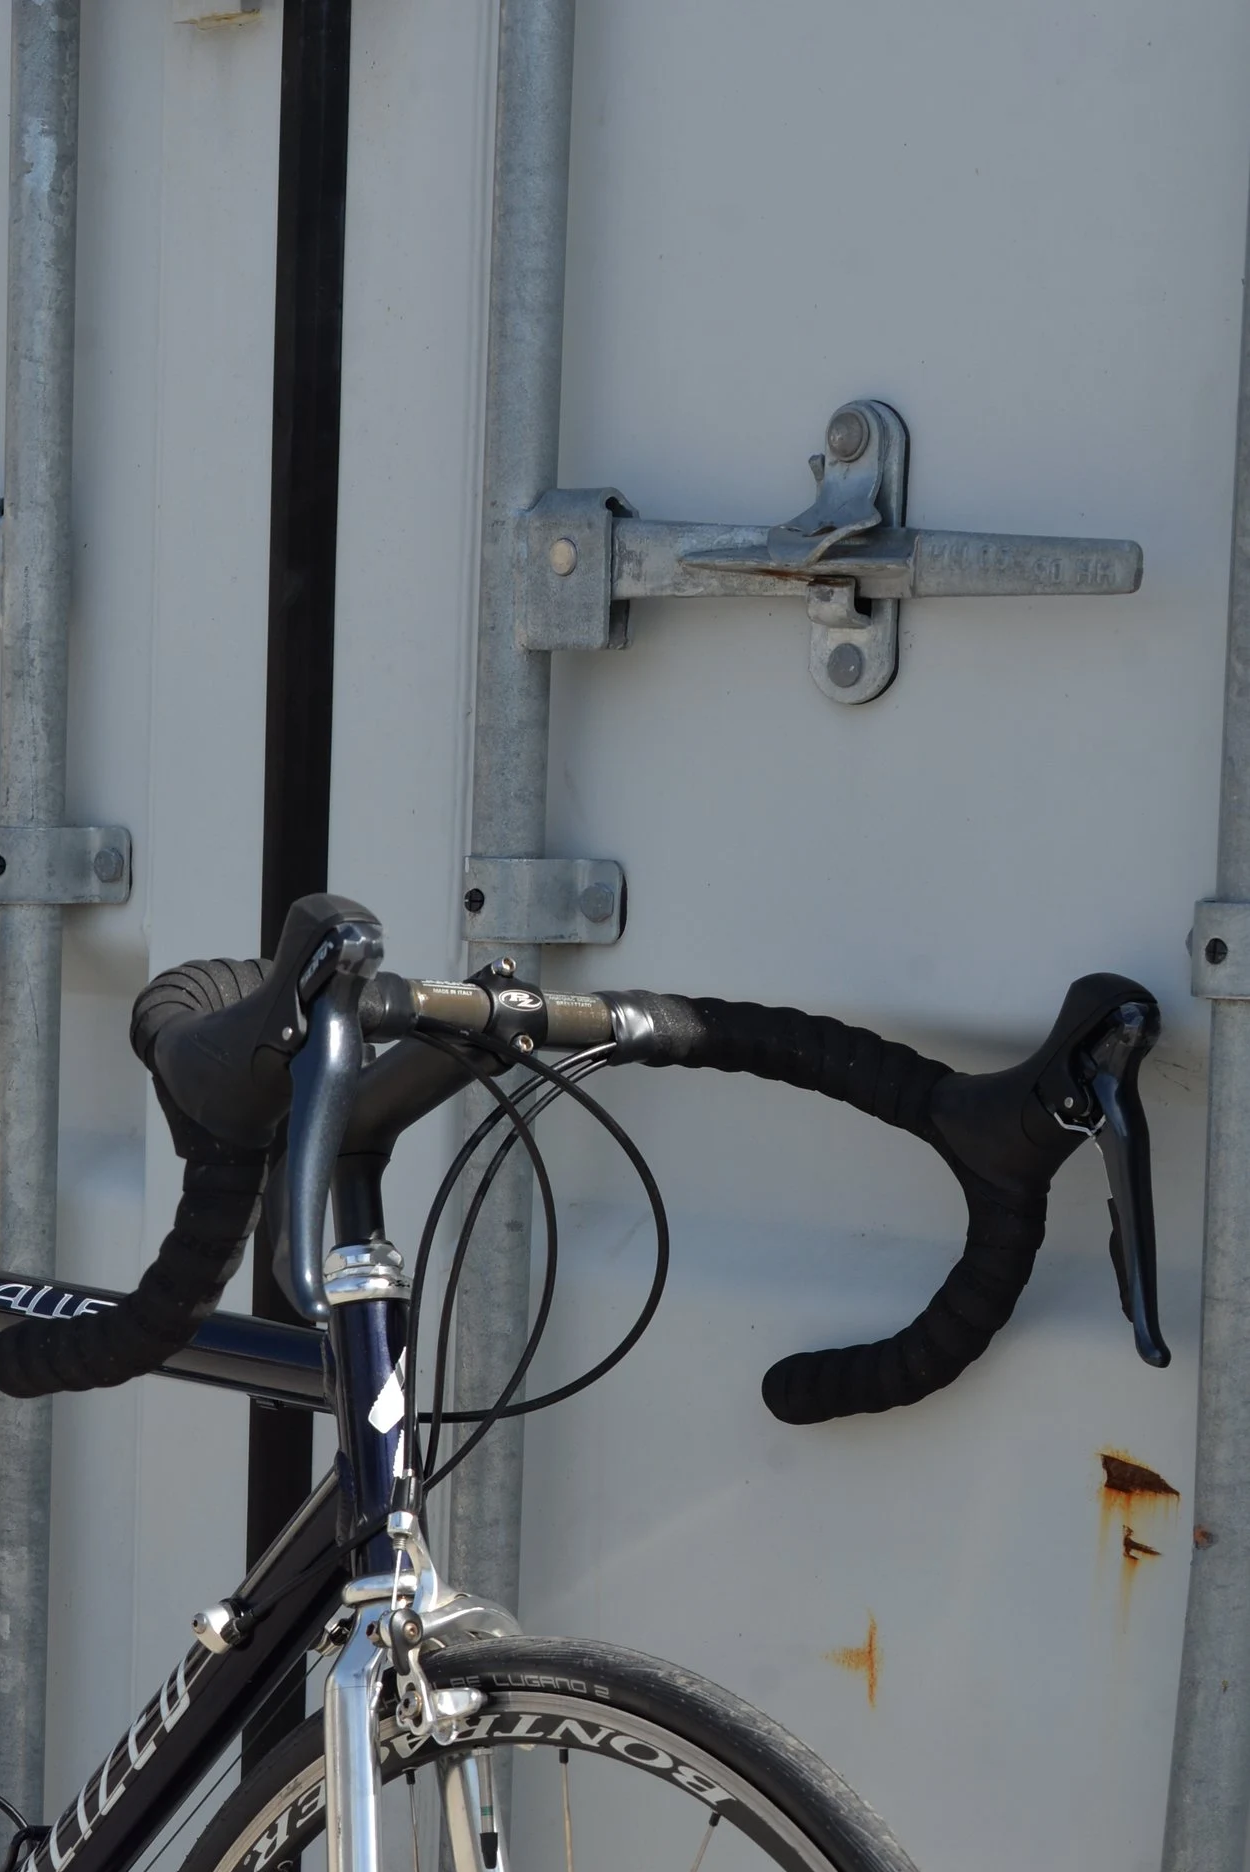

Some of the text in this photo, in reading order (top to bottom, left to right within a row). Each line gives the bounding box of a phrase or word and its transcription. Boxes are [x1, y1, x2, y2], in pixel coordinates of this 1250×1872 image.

[457, 989, 473, 997] ITALY
[492, 1674, 588, 1695] LUGANO
[593, 1684, 611, 1700] 2
